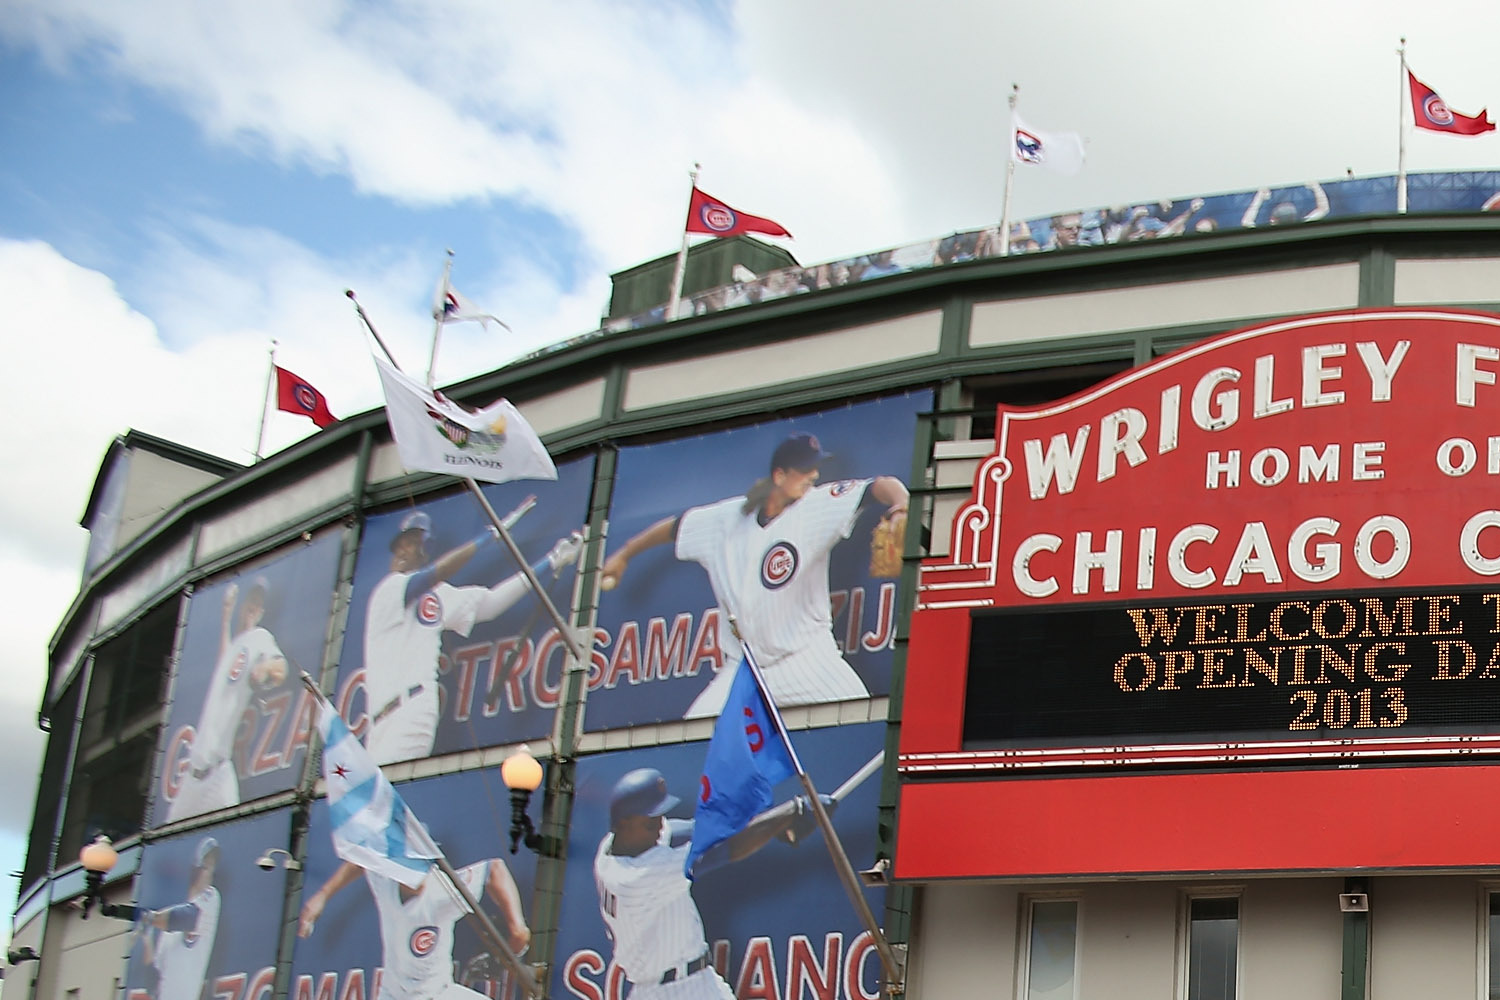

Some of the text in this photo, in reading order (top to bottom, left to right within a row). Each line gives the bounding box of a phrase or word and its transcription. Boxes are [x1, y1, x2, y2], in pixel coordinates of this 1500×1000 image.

[1024, 339, 1411, 500] WRIGLEY
[1206, 441, 1386, 490] HOME
[1011, 514, 1411, 598] CHICAGO
[1125, 596, 1464, 649] WELCOME
[1113, 639, 1411, 692] OPENING
[1289, 687, 1410, 732] 2013
